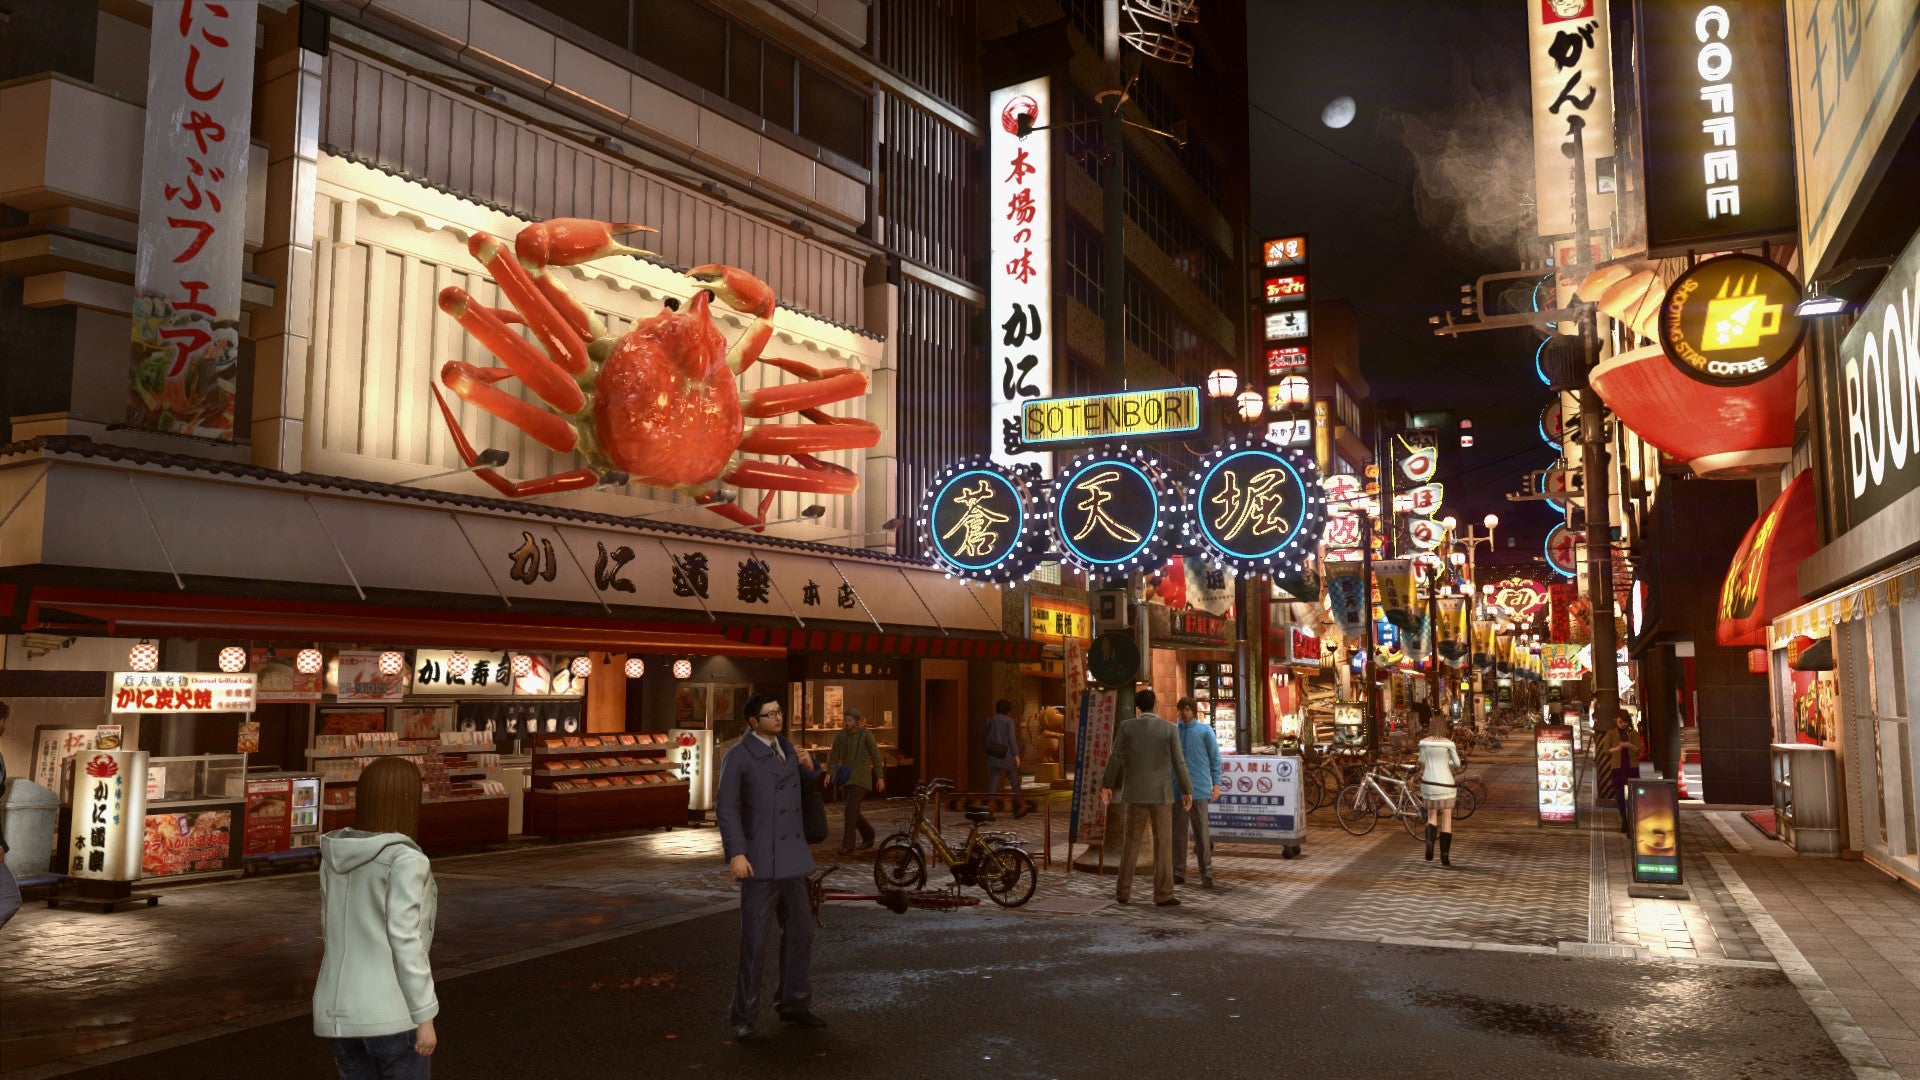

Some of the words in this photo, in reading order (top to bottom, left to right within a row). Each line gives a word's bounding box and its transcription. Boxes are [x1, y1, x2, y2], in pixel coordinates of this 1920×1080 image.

[1694, 4, 1740, 219] COFFEE
[1003, 147, 1038, 285] 本場の味
[1668, 278, 1698, 342] SHOOTING
[1675, 341, 1708, 369] STAR
[1708, 356, 1769, 375] COFFEE
[1026, 398, 1193, 435] SOTENBORI
[508, 530, 770, 605] かに道楽
[802, 578, 857, 609] 本店
[116, 687, 212, 710] かに炭火焼
